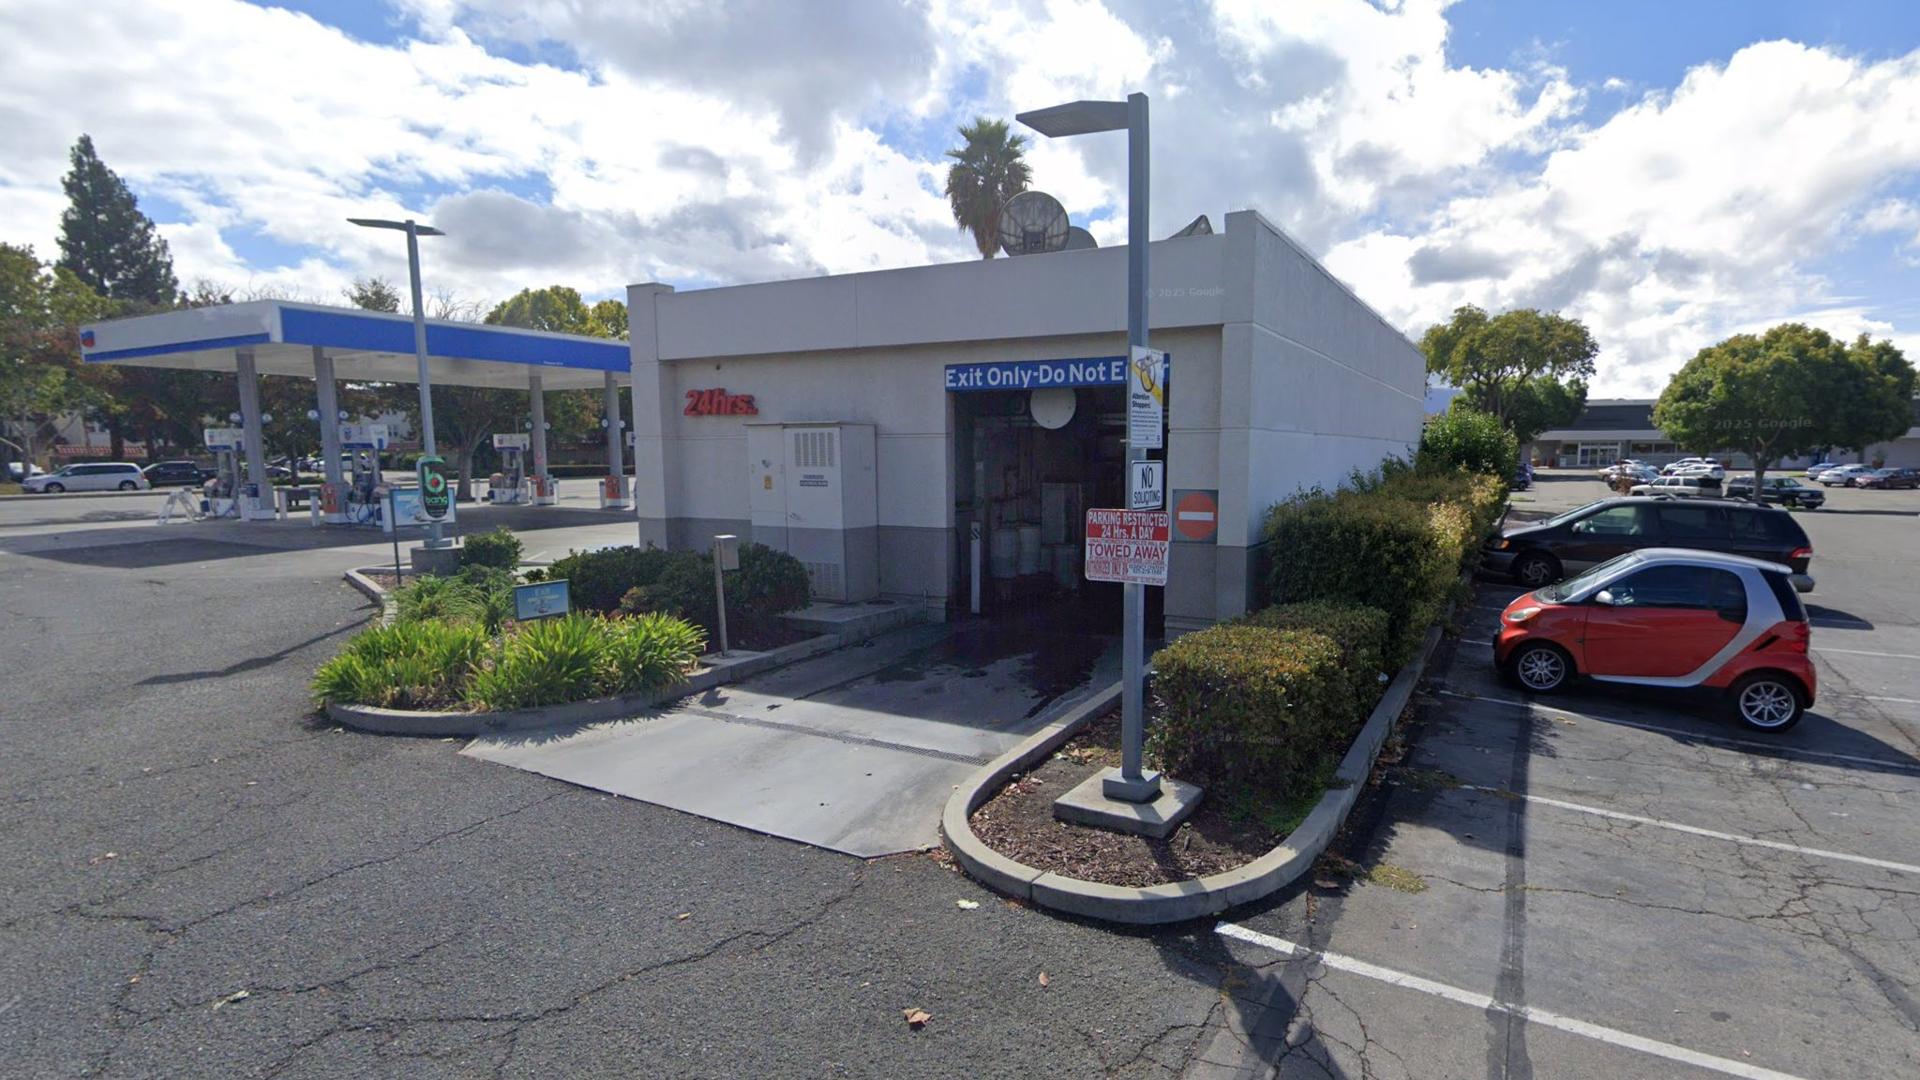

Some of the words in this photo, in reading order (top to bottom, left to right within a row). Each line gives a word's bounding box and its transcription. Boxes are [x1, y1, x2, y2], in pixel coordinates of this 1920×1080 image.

[945, 367, 983, 387] Exit
[1069, 362, 1106, 382] Not
[1141, 466, 1153, 489] NO
[1134, 490, 1160, 505] SOLICITING
[1088, 511, 1121, 525] PARKING
[1123, 513, 1168, 527] RESTRICTED
[1101, 525, 1111, 537] 24
[1131, 527, 1137, 539] A
[1139, 527, 1155, 540] DAY
[1088, 544, 1131, 557] TOWED
[1134, 547, 1168, 560] AWAY
